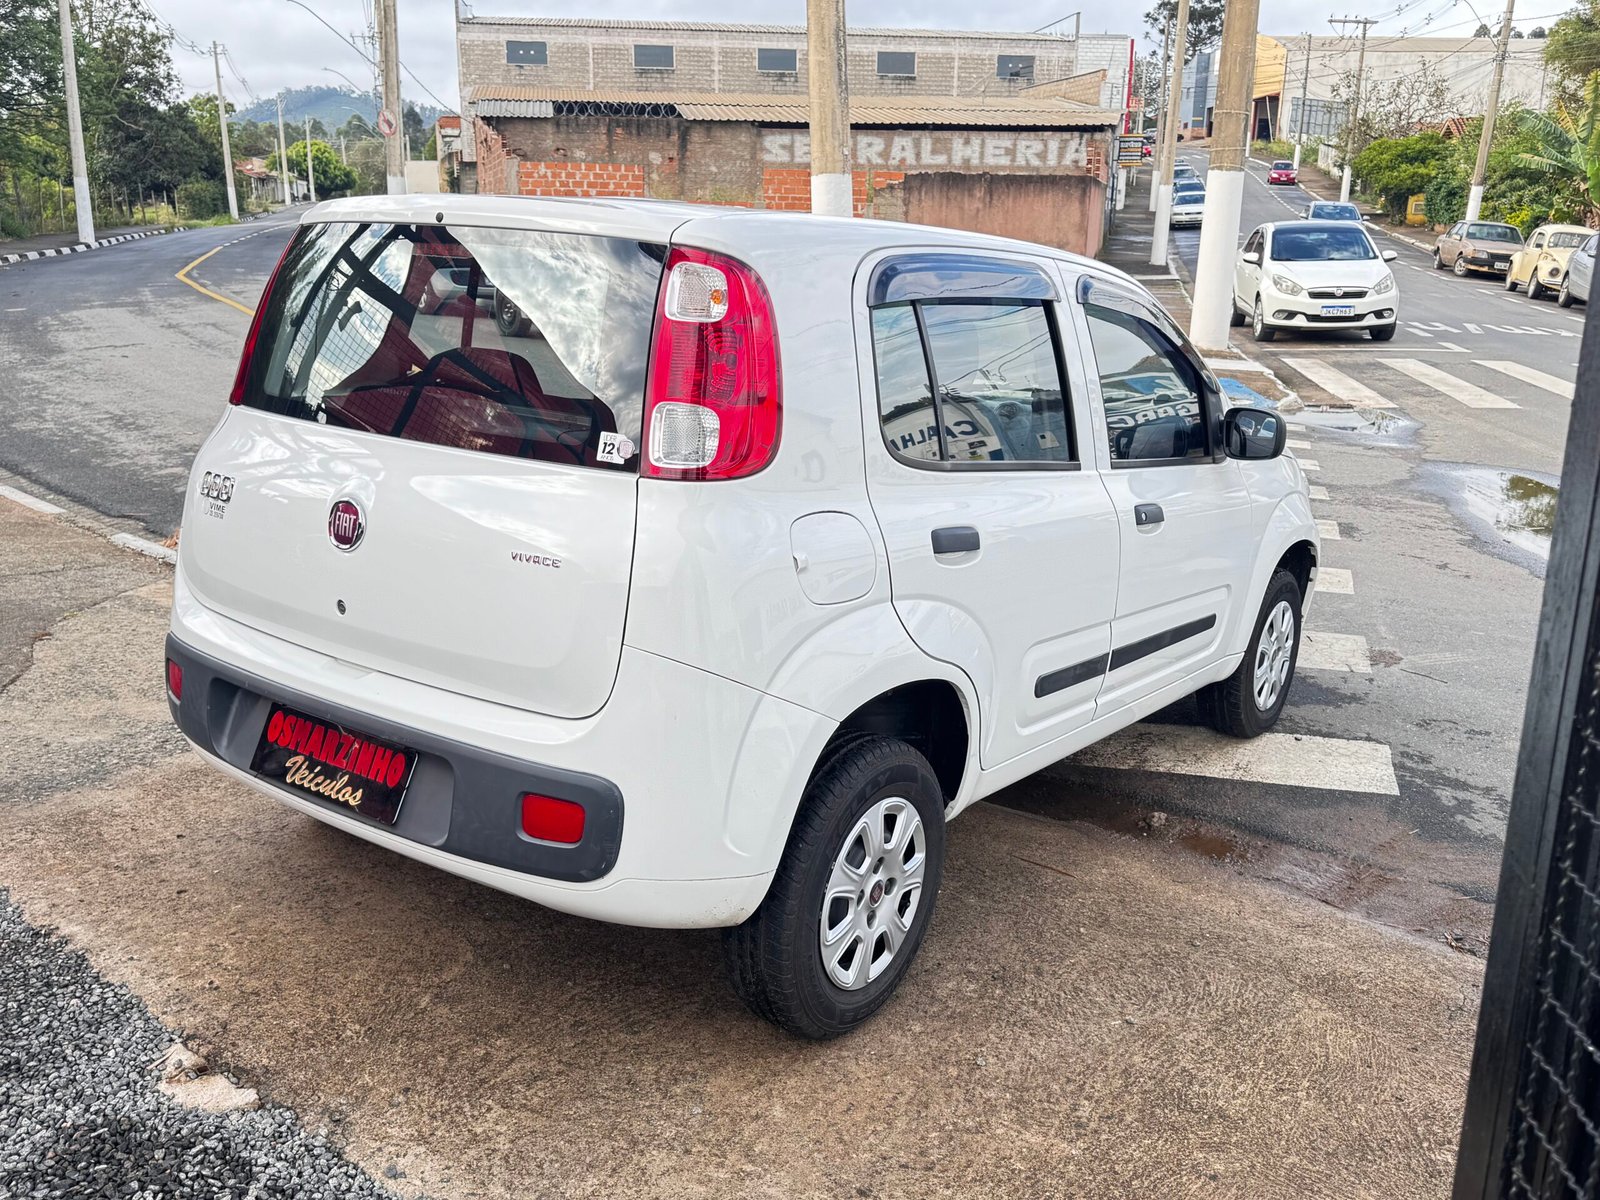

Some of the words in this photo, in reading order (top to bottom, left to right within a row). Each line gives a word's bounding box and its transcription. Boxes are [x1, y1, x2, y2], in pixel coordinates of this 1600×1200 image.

[763, 133, 1088, 168] SERALHERIA
[602, 441, 616, 454] 12
[333, 510, 358, 538] FIAT
[510, 551, 562, 569] VIVACE
[267, 710, 406, 788] OSMARZINHO
